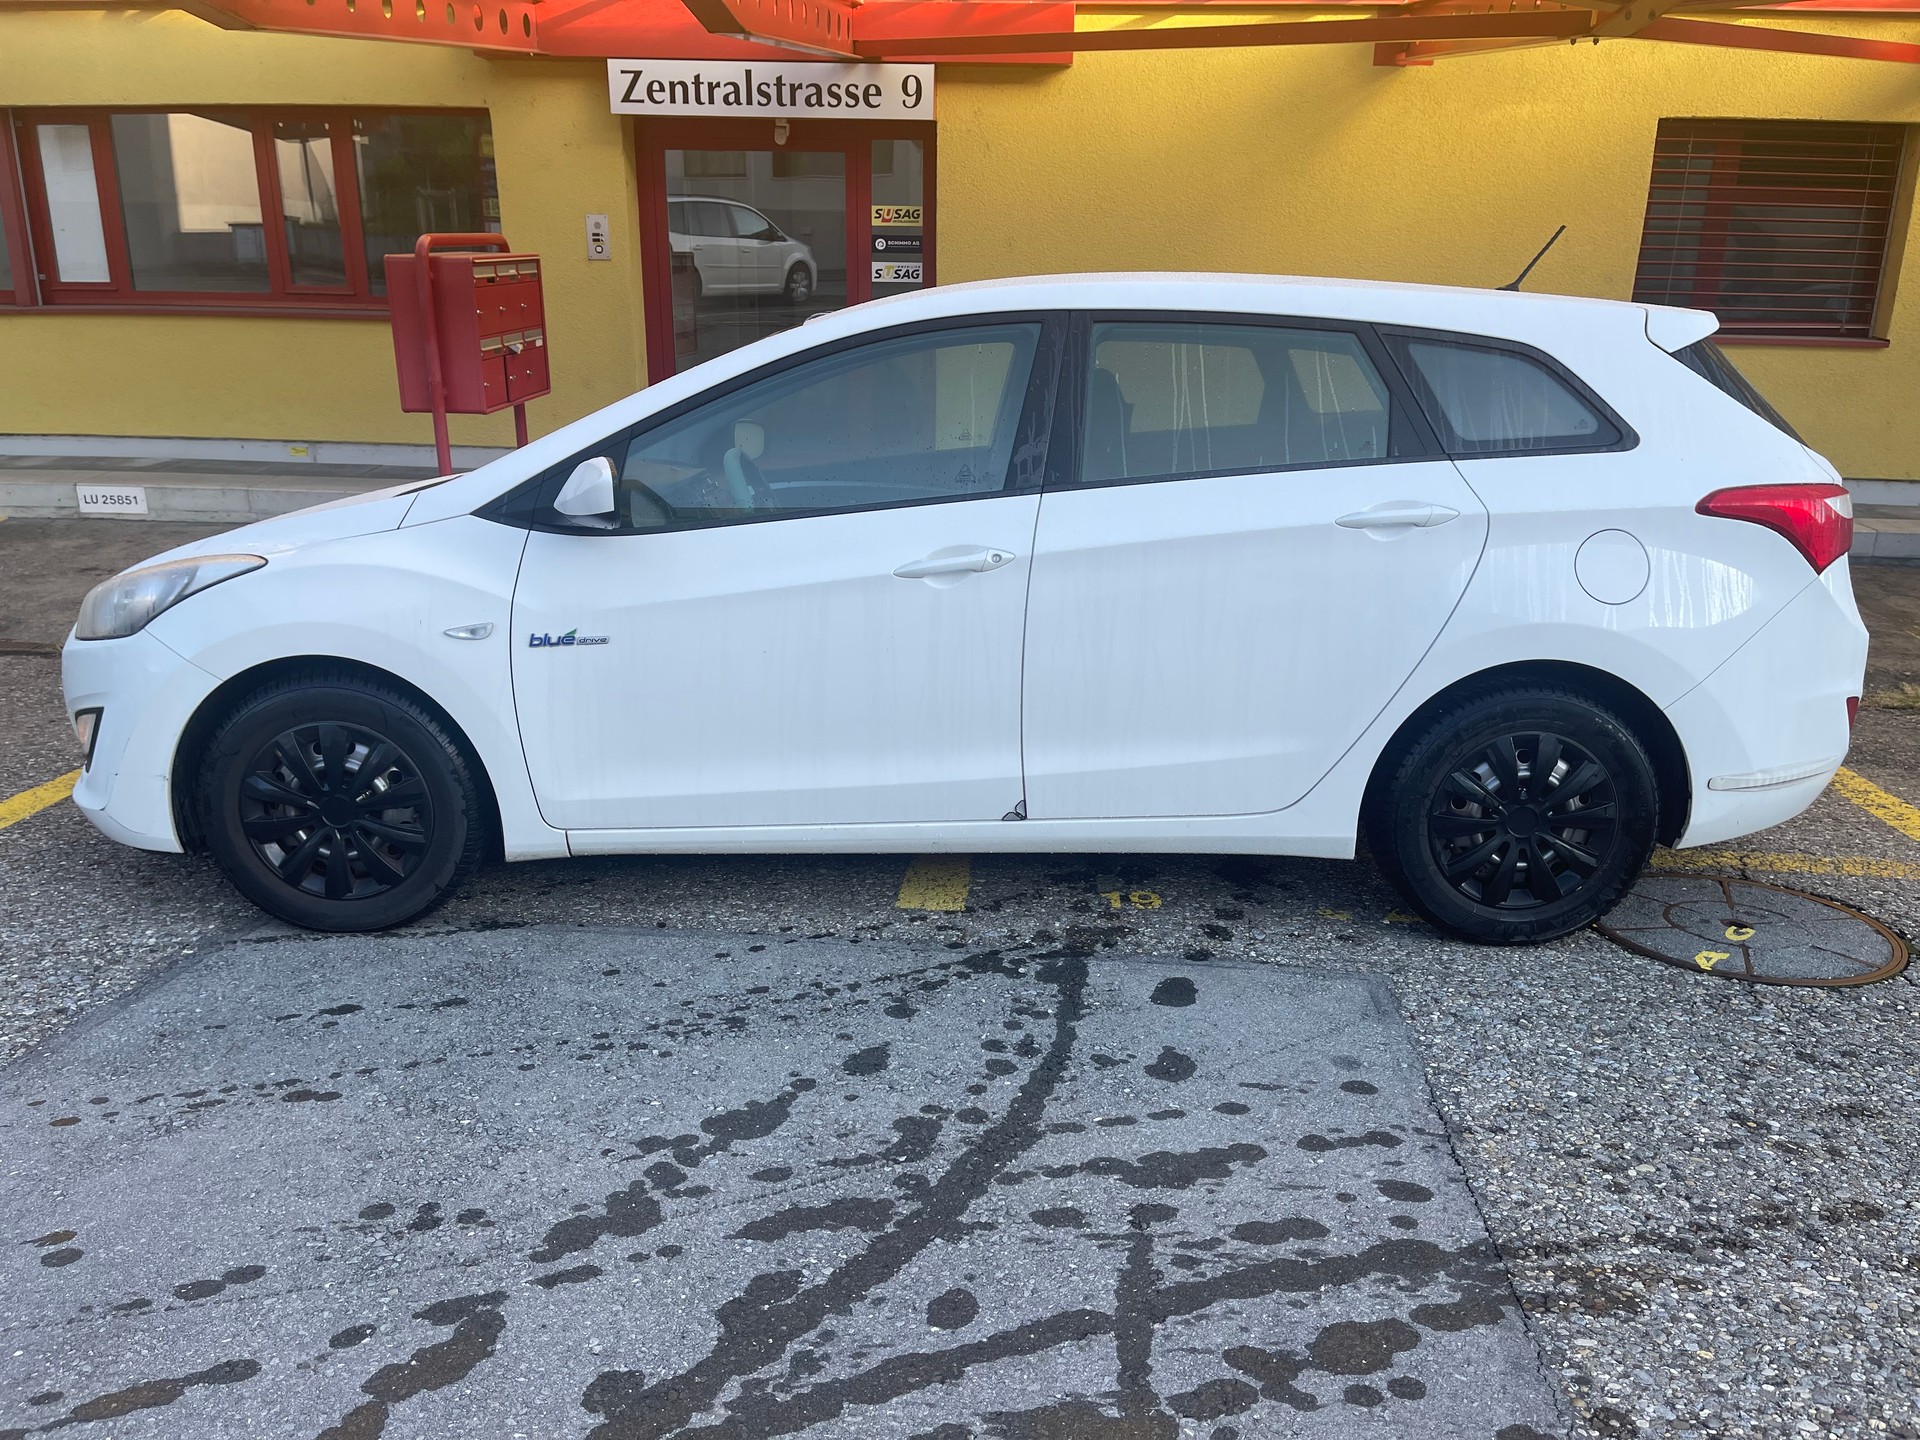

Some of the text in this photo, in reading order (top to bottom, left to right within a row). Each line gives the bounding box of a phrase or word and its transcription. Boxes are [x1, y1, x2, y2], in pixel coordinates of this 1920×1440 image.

[620, 69, 923, 109] Zentralstrasse 9
[874, 208, 920, 222] SUSAG
[83, 494, 138, 505] LU 25851
[578, 636, 608, 645] drive
[1100, 890, 1163, 910] 19
